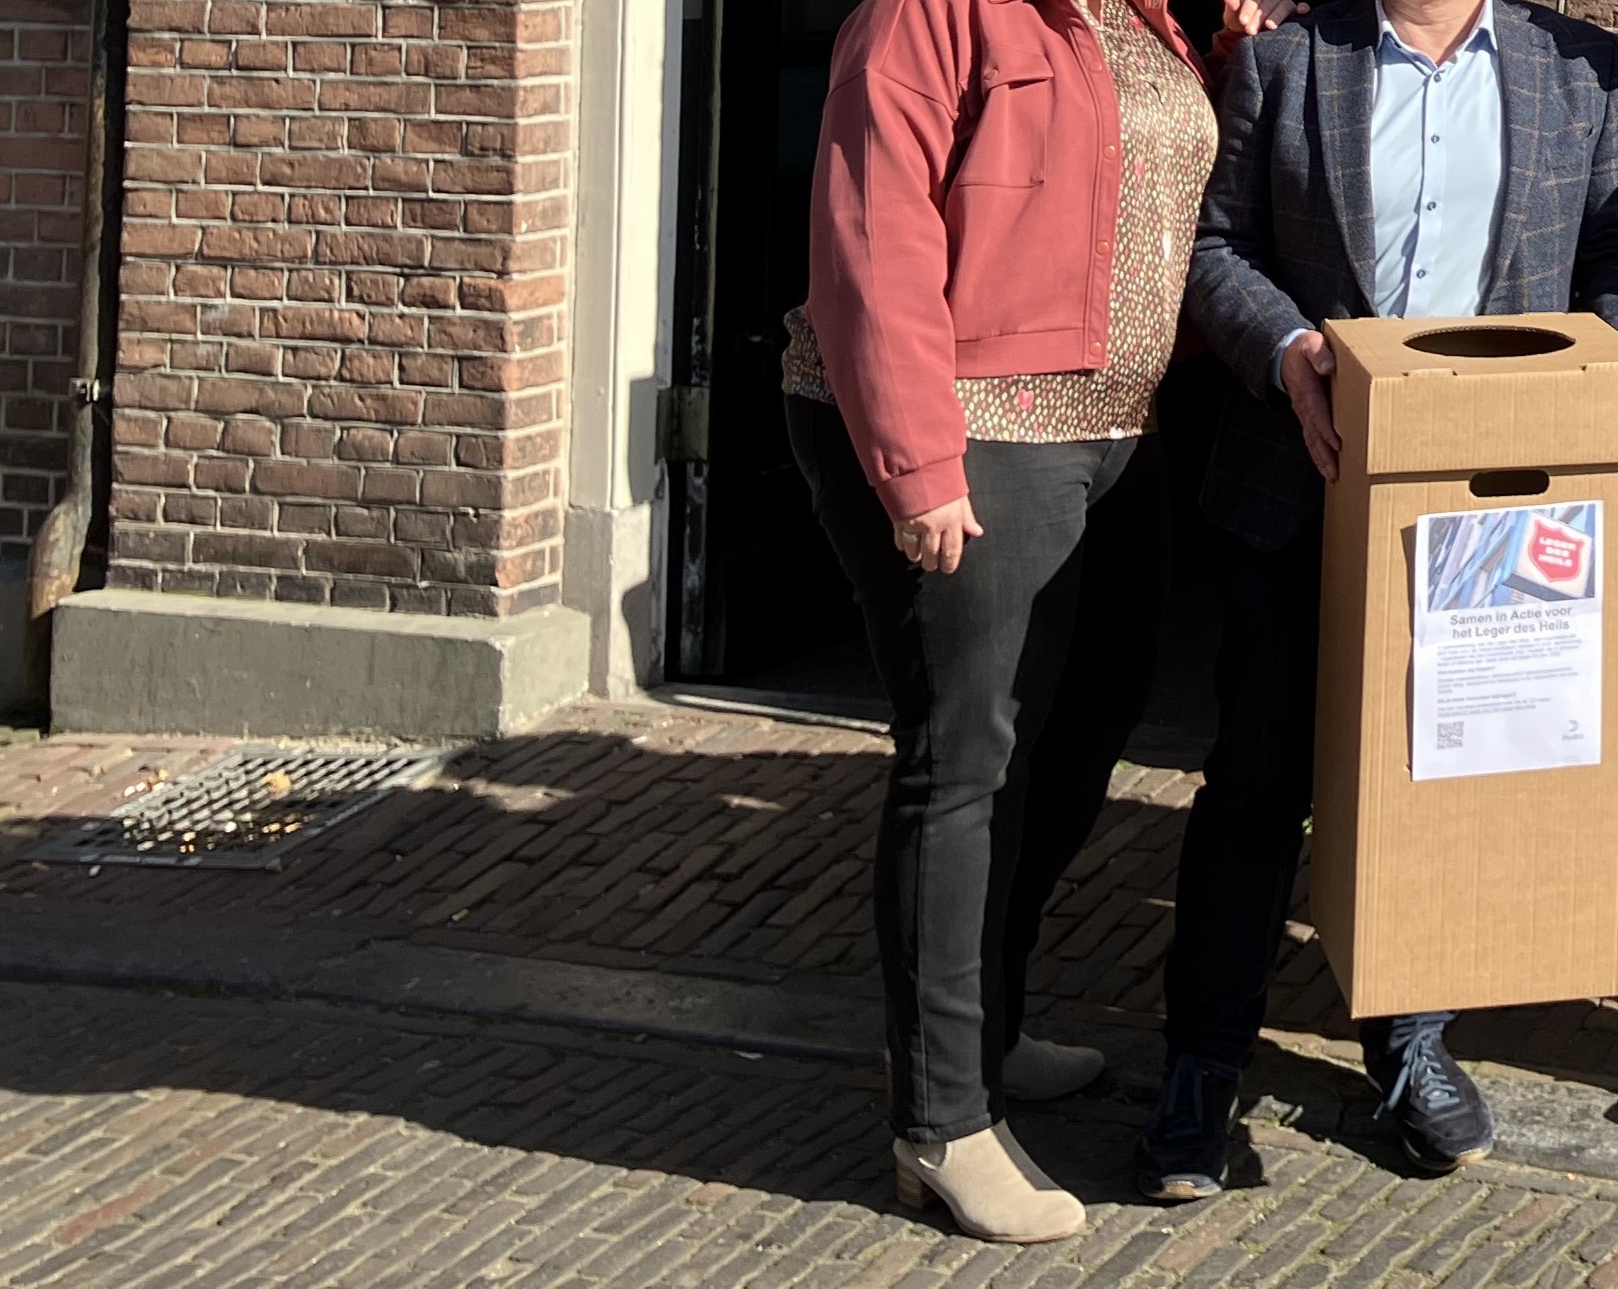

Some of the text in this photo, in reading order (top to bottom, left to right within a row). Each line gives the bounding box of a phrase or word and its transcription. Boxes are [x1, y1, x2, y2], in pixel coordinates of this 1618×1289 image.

[1450, 613, 1492, 626] Samen
[1496, 611, 1507, 622] in
[1545, 607, 1573, 617] voor
[1452, 619, 1570, 639] het Leger des Heils
